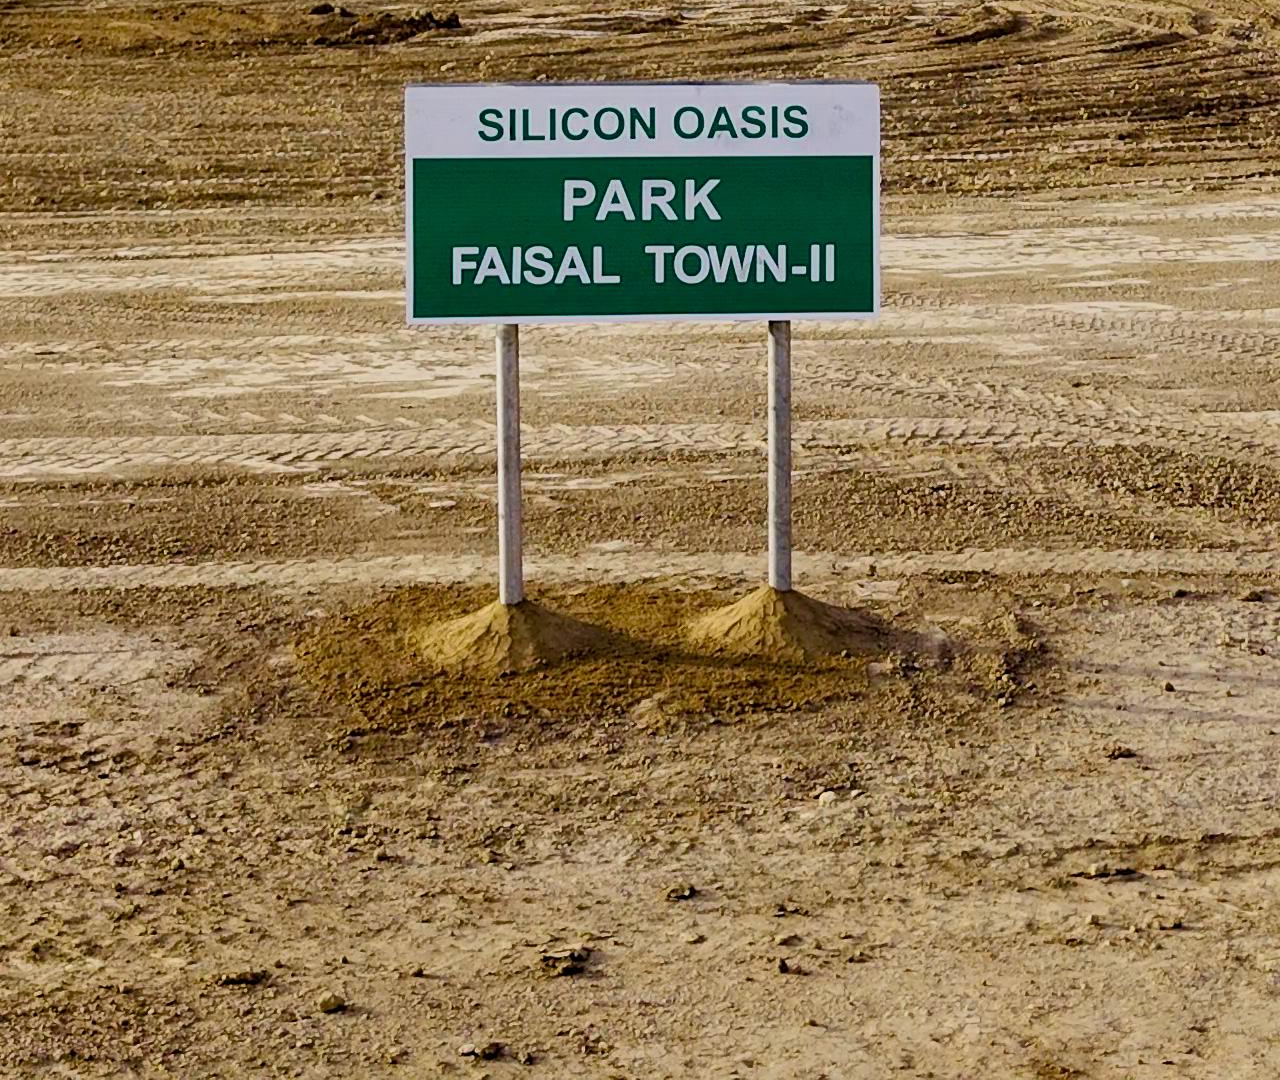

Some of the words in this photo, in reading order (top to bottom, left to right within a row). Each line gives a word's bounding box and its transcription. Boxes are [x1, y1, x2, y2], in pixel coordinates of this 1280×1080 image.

[477, 106, 656, 142] SILICON
[673, 105, 809, 140] OASIS
[563, 178, 722, 222] PARK
[452, 245, 621, 286] FAISAL
[644, 243, 836, 284] TOWN-II
